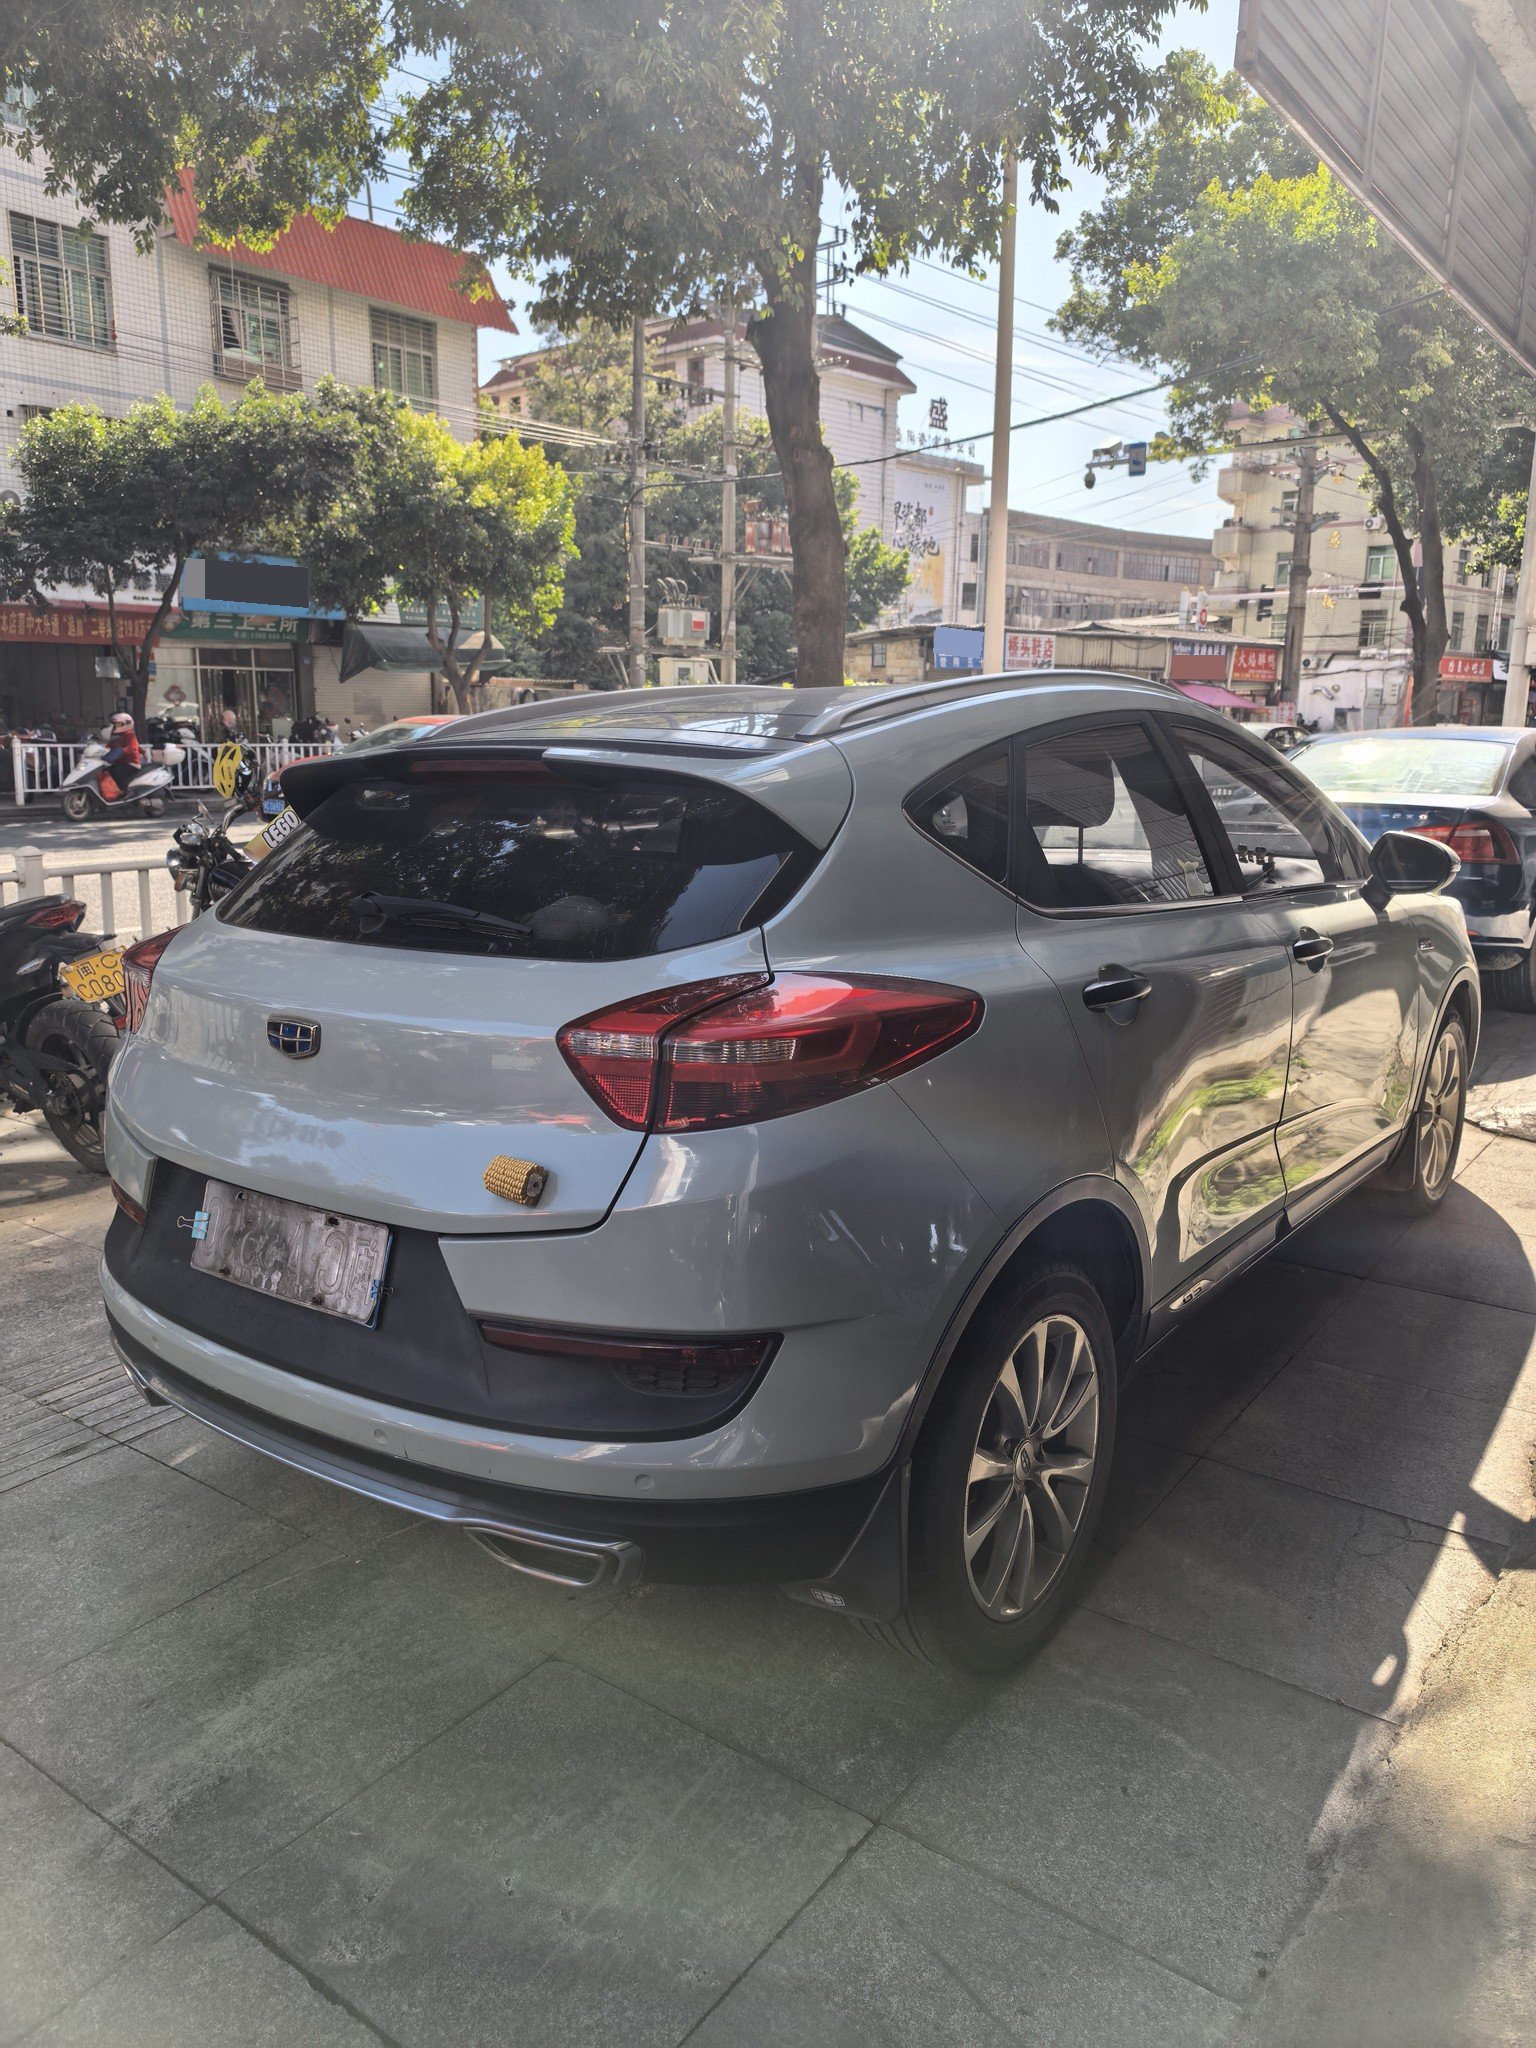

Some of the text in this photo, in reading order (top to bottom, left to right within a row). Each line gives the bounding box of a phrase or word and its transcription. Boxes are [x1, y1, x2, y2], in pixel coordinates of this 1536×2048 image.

[929, 396, 948, 431] 盛
[1008, 636, 1054, 658] 桥头鞋店
[262, 810, 300, 849] LEGO
